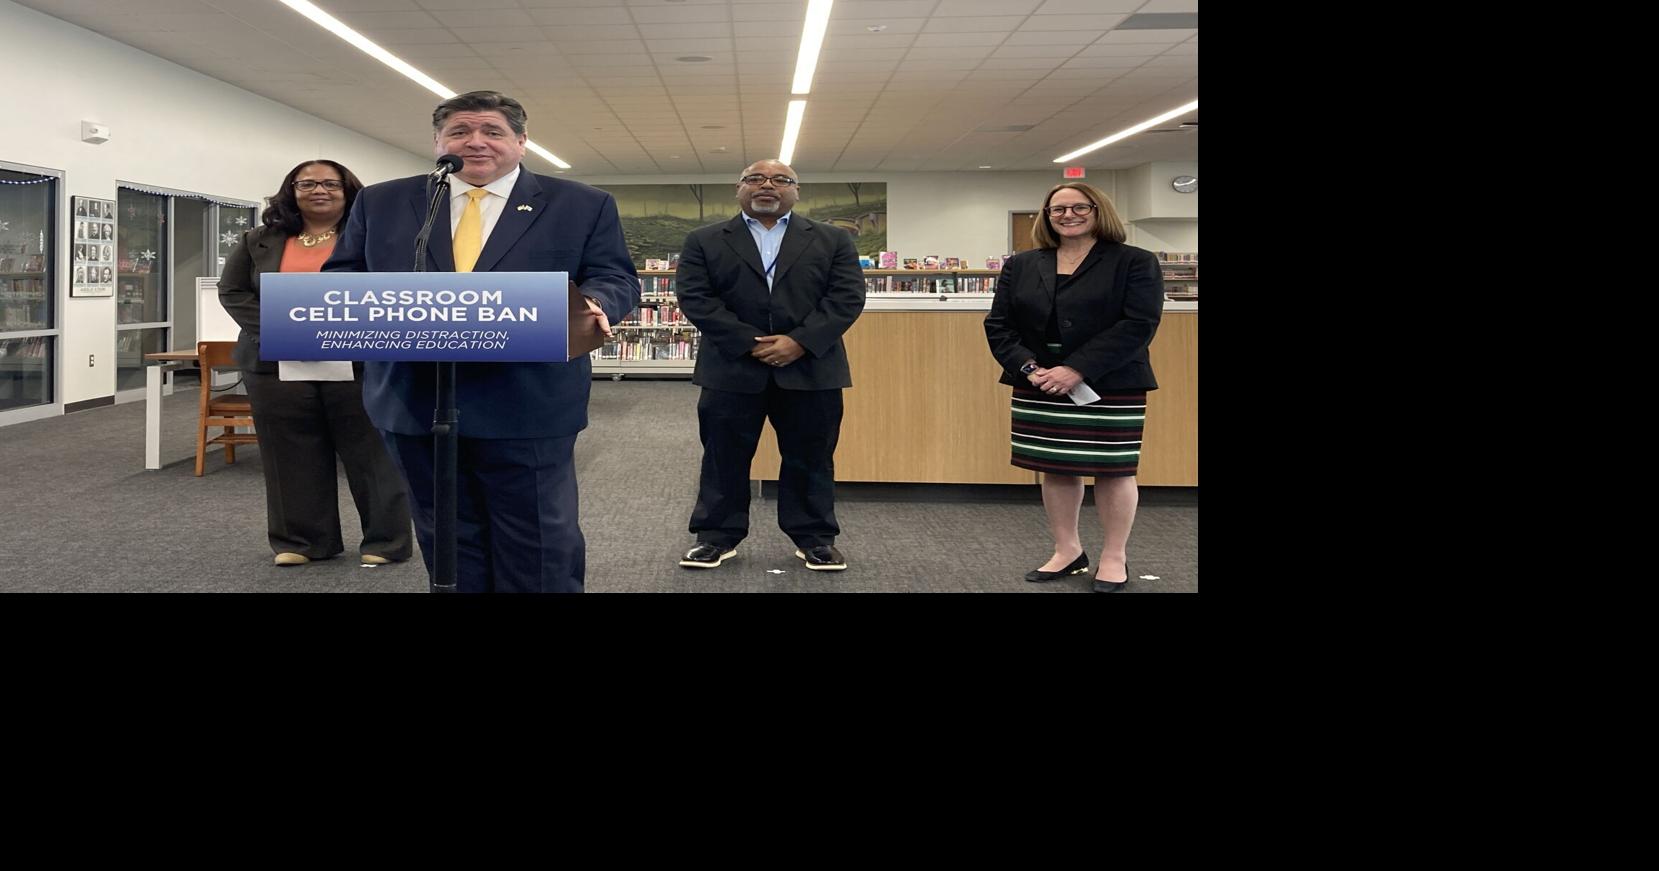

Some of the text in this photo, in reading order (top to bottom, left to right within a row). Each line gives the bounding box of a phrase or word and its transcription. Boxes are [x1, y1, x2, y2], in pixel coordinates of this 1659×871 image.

[323, 290, 503, 305] CLASSROOM
[289, 307, 538, 322] CELL PHONE BAN
[316, 330, 510, 341] MINIMIZING DISTRACTION,
[321, 340, 506, 349] ENHANCING EDUCATION
